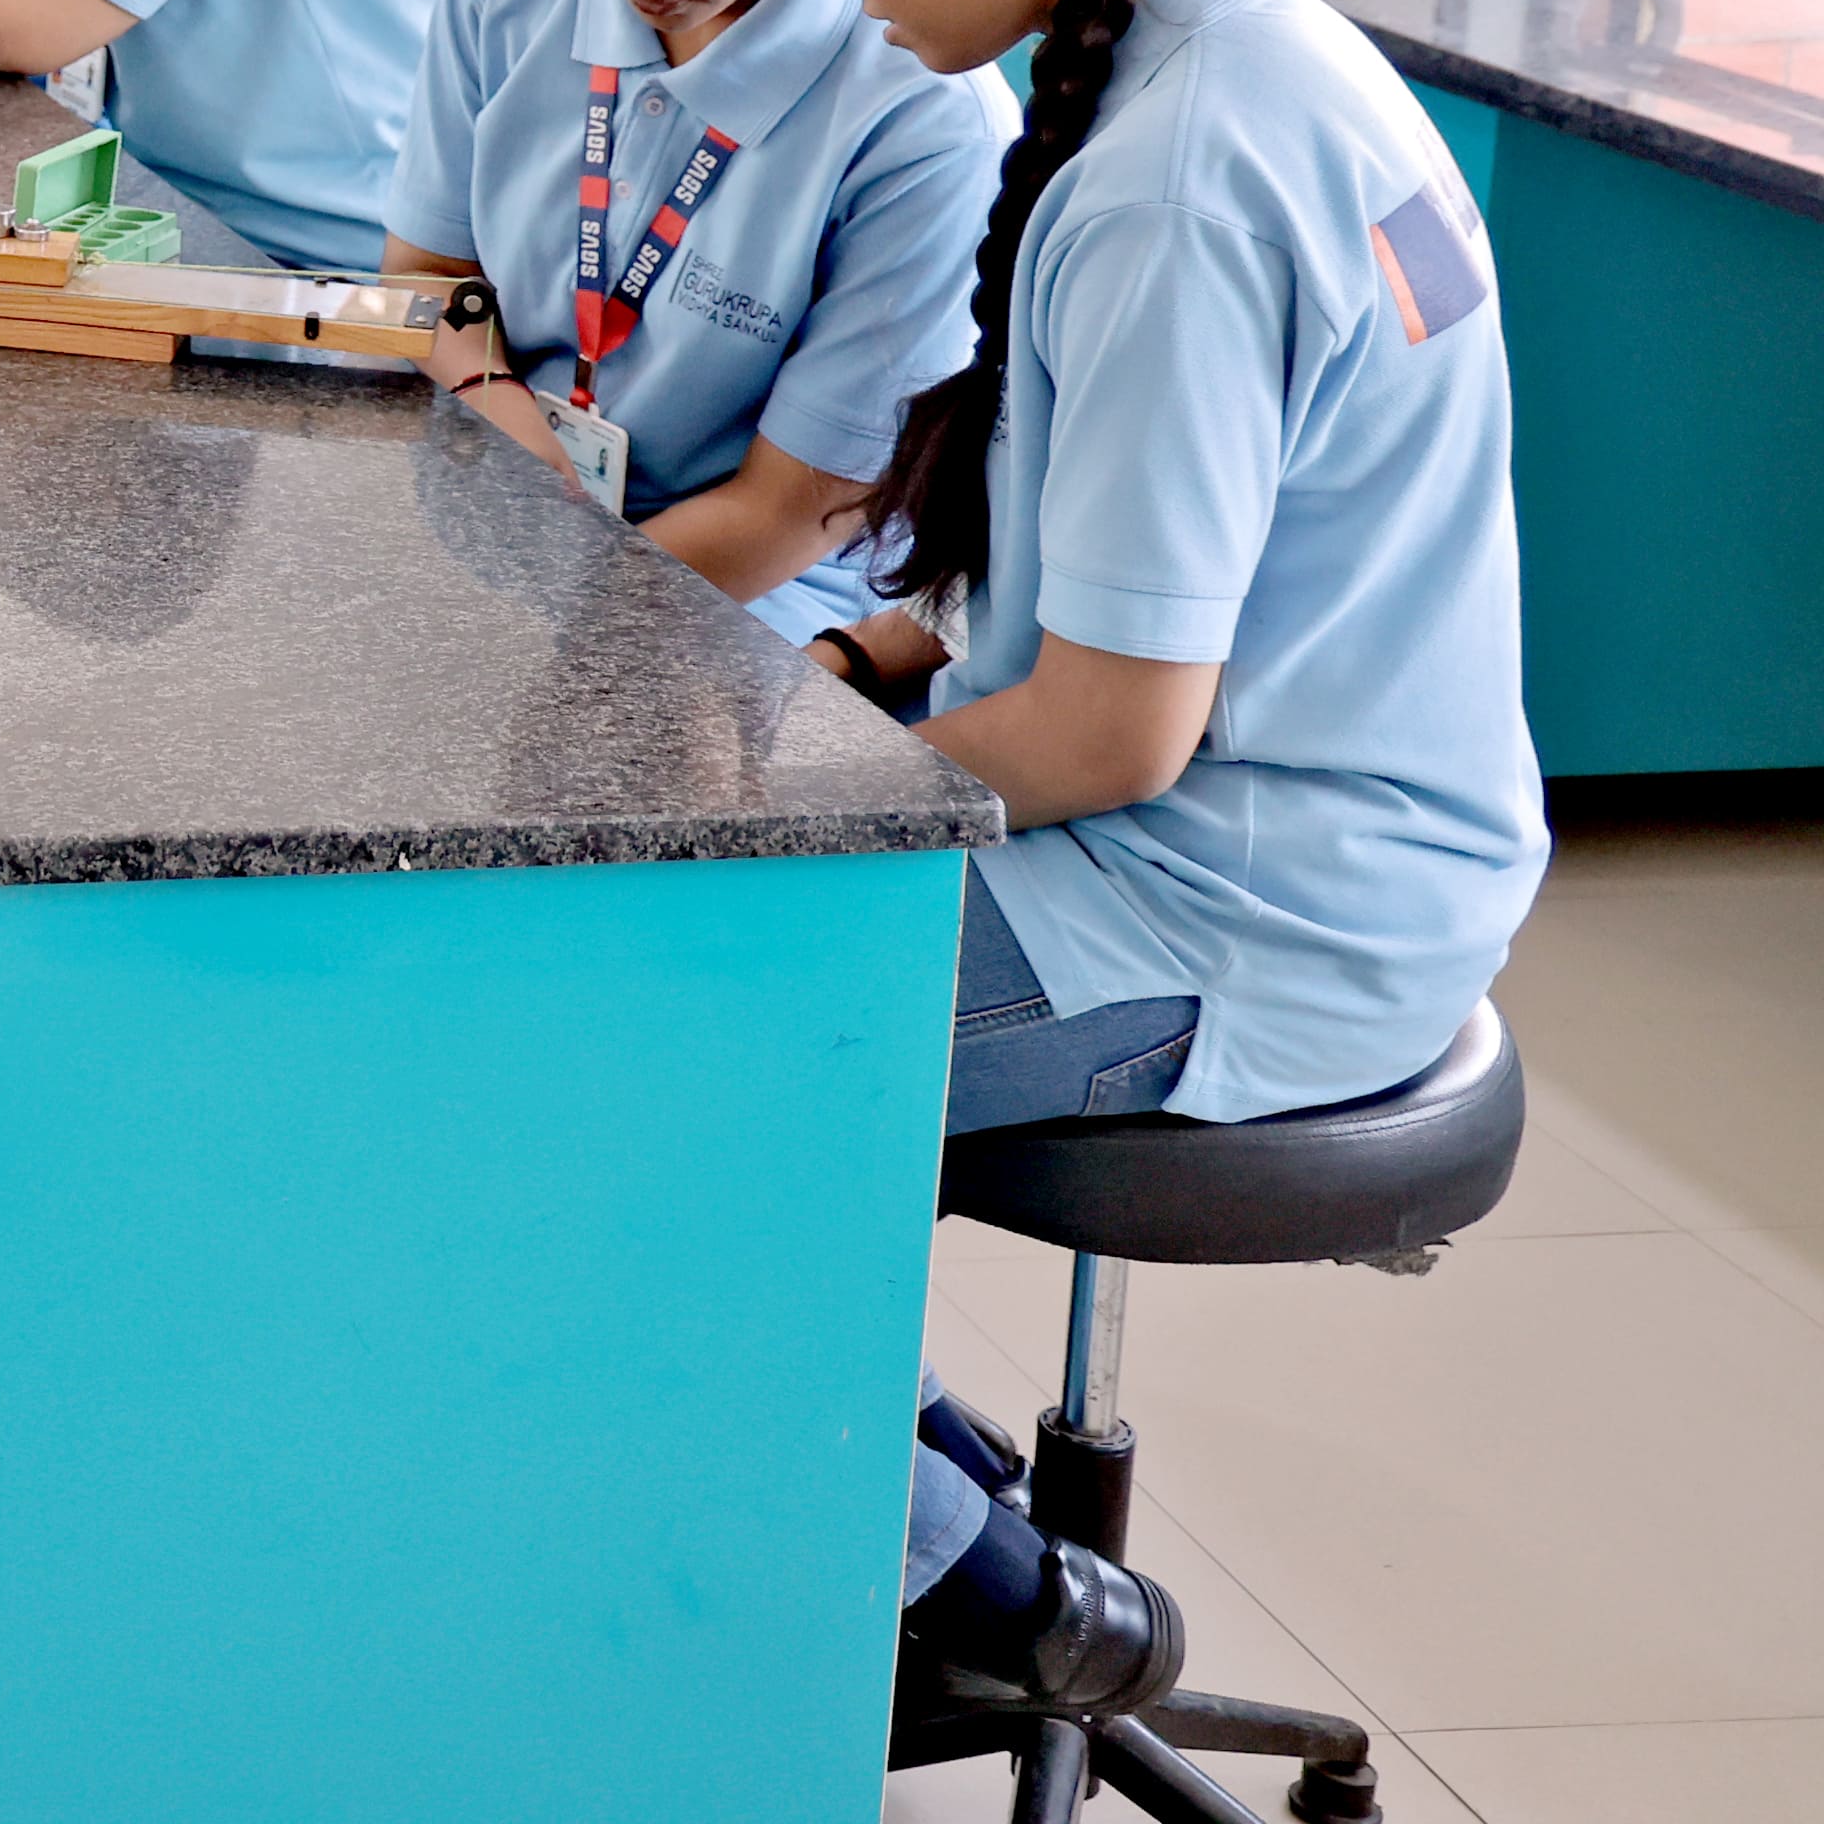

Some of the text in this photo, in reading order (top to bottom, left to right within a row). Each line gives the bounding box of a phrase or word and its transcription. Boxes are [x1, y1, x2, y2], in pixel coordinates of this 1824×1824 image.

[586, 105, 609, 164] SGVS
[674, 148, 719, 206] SGVS
[580, 220, 601, 279] SGVS
[621, 243, 662, 298] SGVS
